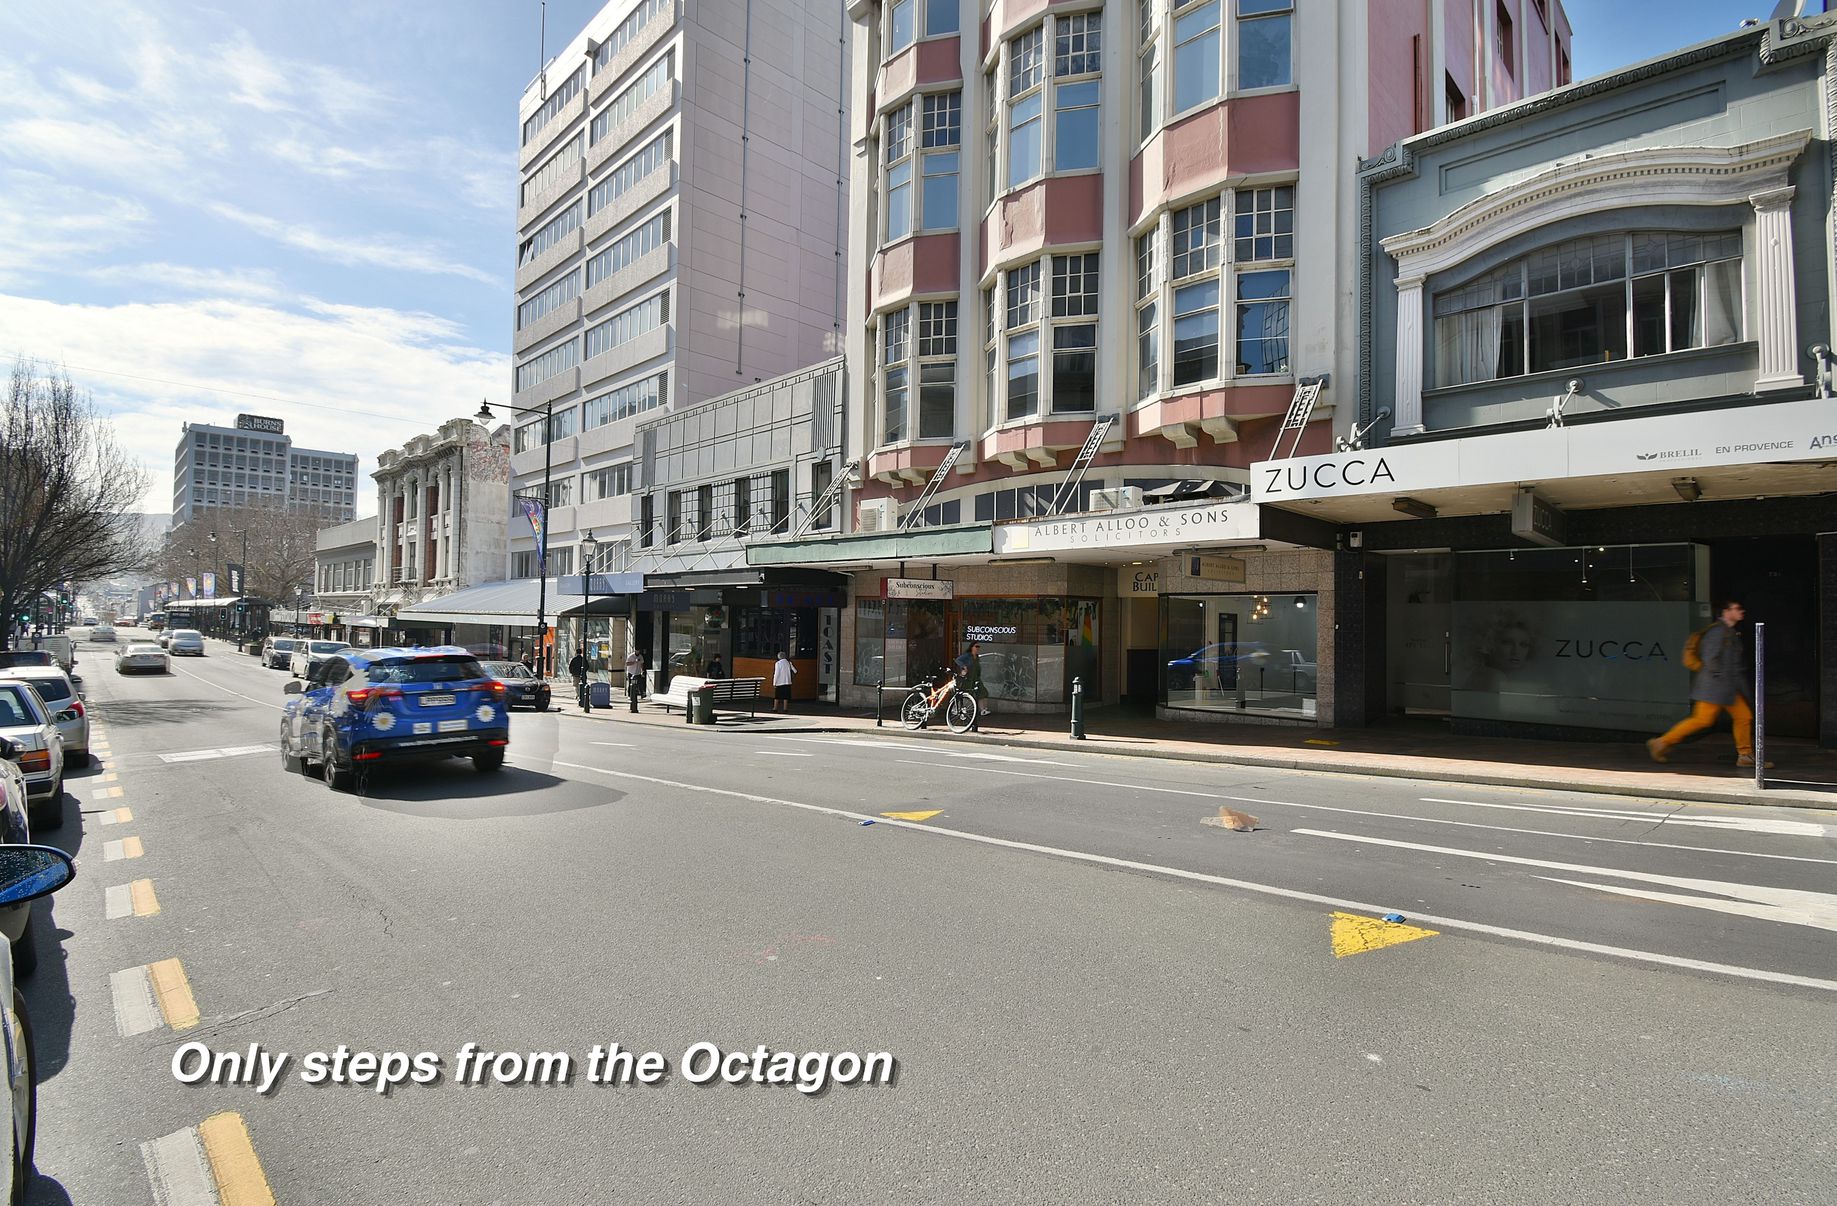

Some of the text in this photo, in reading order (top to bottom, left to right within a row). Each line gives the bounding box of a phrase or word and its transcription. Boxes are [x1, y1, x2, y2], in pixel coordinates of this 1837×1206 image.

[254, 418, 282, 426] BURNS
[253, 424, 281, 432] HOUSE
[1715, 441, 1794, 454] EN PROVENCE
[1660, 448, 1702, 459] BRELIL
[1265, 457, 1395, 493] ZUCCA
[1034, 510, 1229, 537] ALBERT ALLOO & SONS
[1070, 528, 1181, 544] SOLICITORS
[1135, 571, 1159, 582] CAP
[895, 581, 935, 590] Subconscious
[1132, 582, 1157, 592] BUIL
[967, 625, 1016, 634] SUBCONSCIOUS
[966, 633, 993, 642] STUDIOS
[822, 615, 834, 674] TOAST
[1555, 639, 1668, 662] ZUCCA
